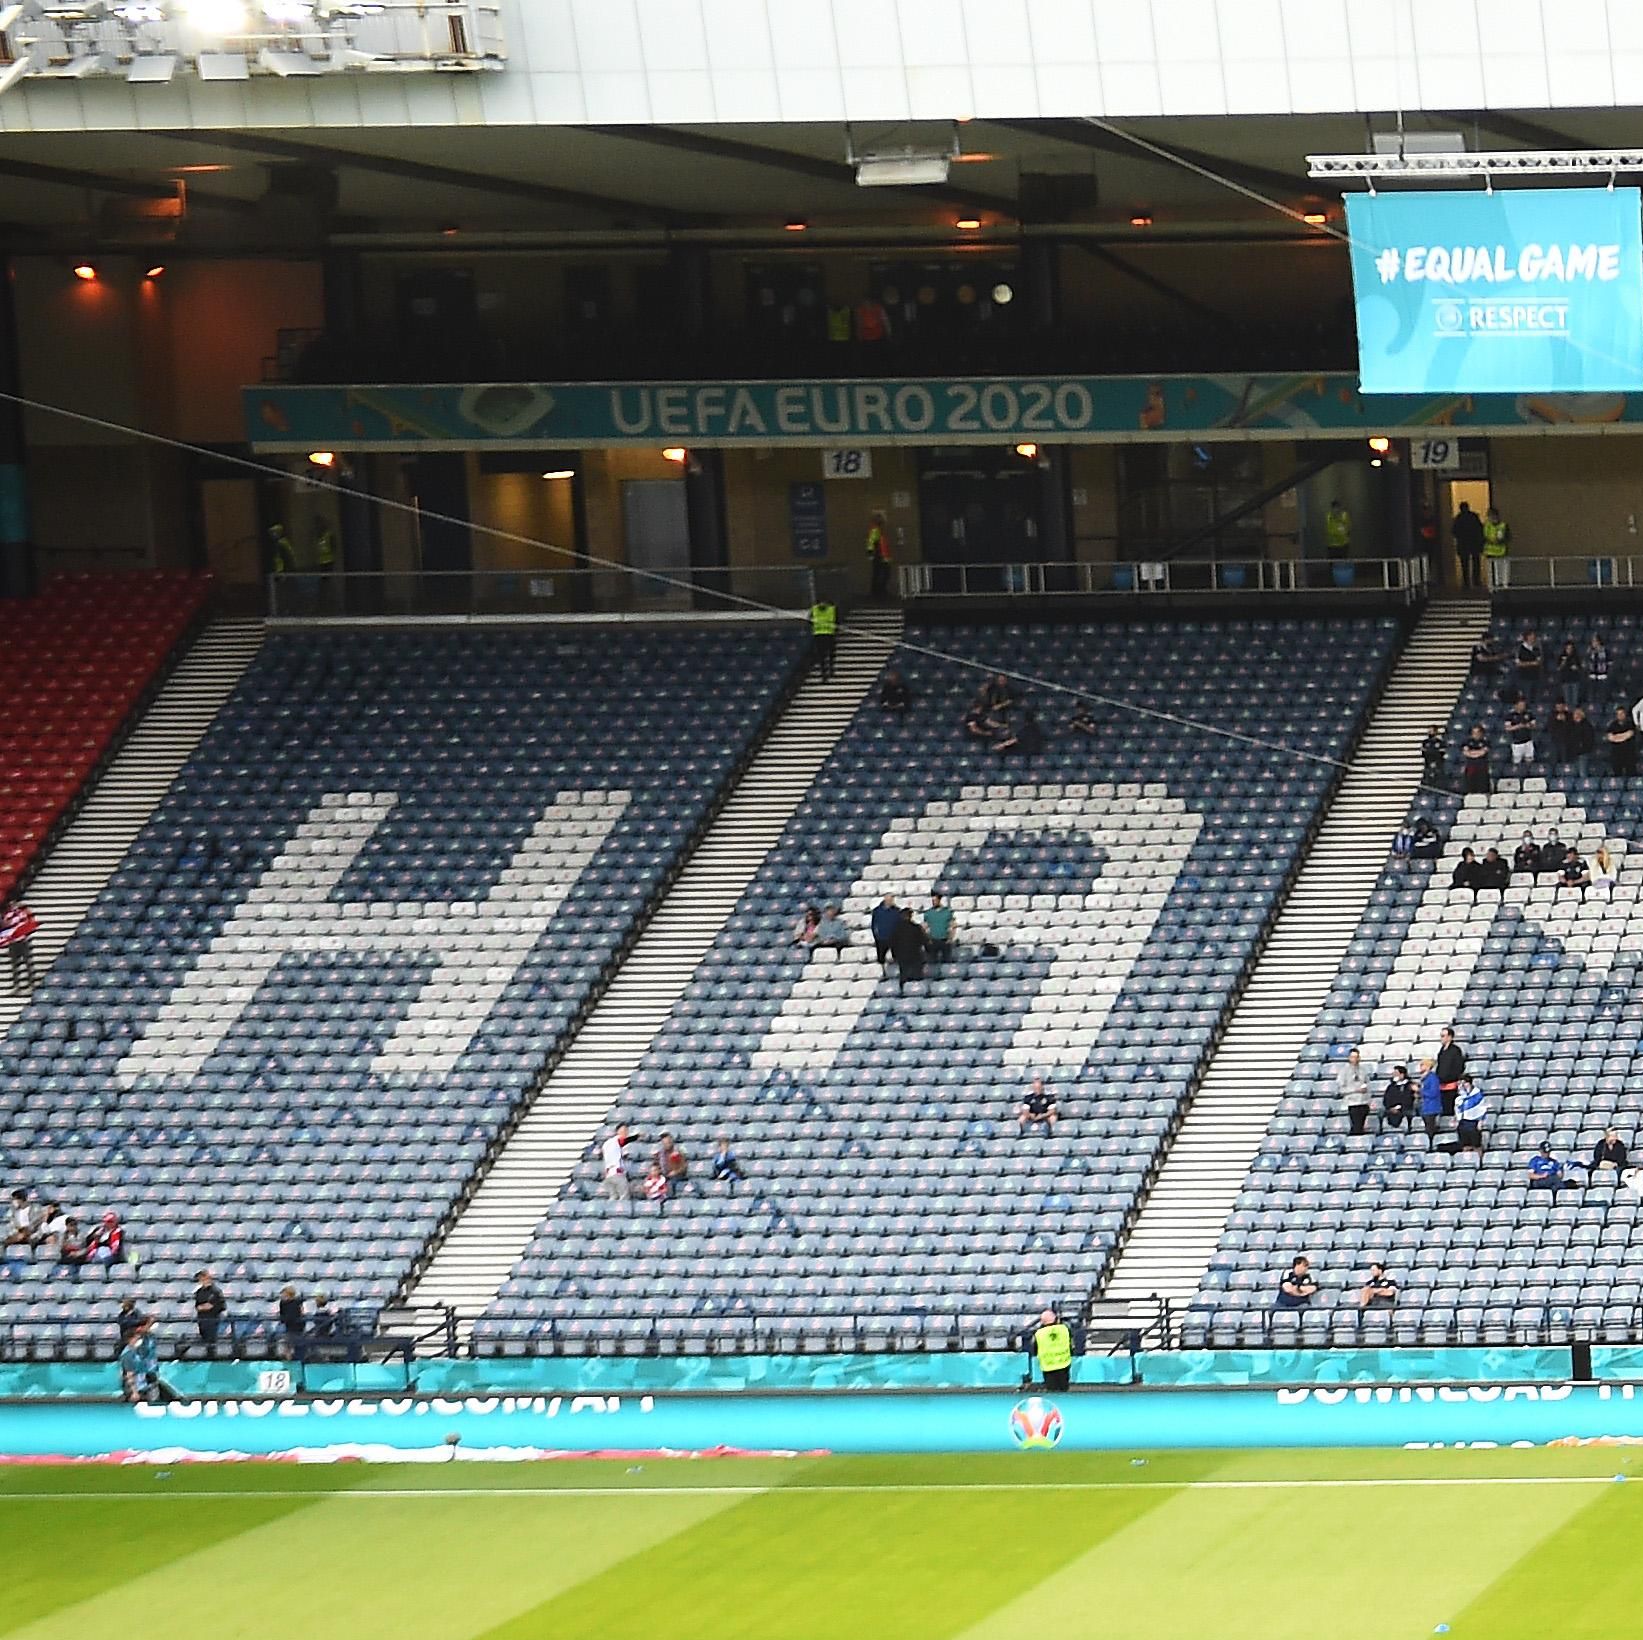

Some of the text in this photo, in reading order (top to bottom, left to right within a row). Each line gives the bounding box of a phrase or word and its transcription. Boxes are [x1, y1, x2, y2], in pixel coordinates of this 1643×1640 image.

[1469, 305, 1568, 329] RESPECT
[611, 383, 1093, 435] UEFA EURO 2020
[832, 451, 860, 473] 18
[1422, 441, 1448, 464] 19
[263, 1373, 286, 1391] 18
